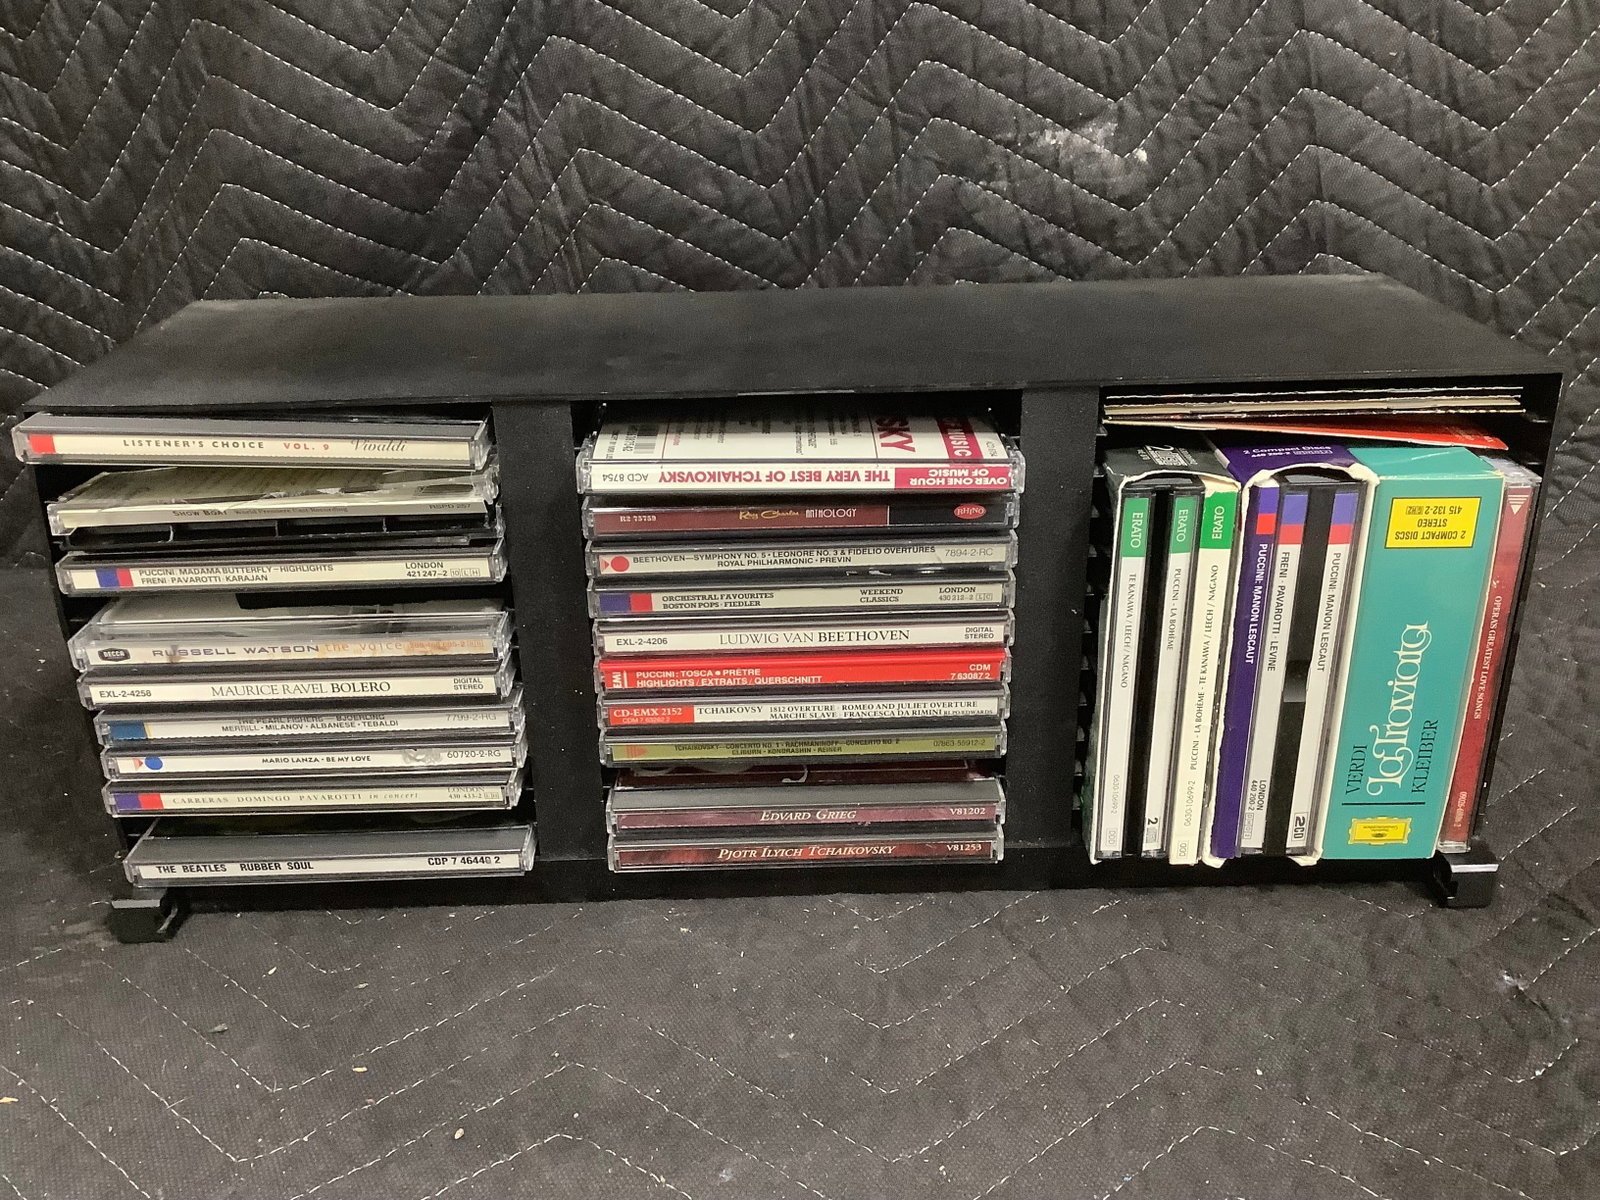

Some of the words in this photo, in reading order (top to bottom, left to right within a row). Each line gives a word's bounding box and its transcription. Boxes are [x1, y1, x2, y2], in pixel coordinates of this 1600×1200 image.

[123, 439, 204, 448] LISTENER'S
[212, 440, 264, 449] CHOICE
[283, 442, 315, 450] VOL.
[322, 443, 330, 451] 9
[350, 438, 408, 452] Vivaldi
[602, 473, 625, 482] 8754
[627, 473, 649, 482] ACD
[658, 471, 762, 483] TCHAIKOVSKY
[765, 470, 786, 483] OF
[789, 470, 822, 482] BEST
[826, 470, 862, 482] VERY
[865, 469, 890, 482] THE
[928, 468, 970, 477] MUSIC
[972, 468, 989, 477] OF
[909, 477, 947, 486] HOUR
[948, 477, 974, 486] ONE
[976, 477, 1008, 486] OVER
[956, 507, 985, 516] RHINO
[1424, 505, 1446, 515] 132-2
[1448, 505, 1463, 515] 415
[1176, 509, 1189, 542] ERATO
[1211, 505, 1225, 540] ERATO
[1417, 518, 1448, 528] STEREO
[1130, 512, 1144, 548] ERATO
[1394, 531, 1419, 540] DISCS
[1421, 530, 1458, 540] COMPACT
[1461, 530, 1467, 539] 2
[772, 550, 815, 558] LEONORE
[848, 547, 883, 555] FIDELIO
[884, 546, 936, 554] OVERTURES
[747, 557, 813, 566] PHILHARMONIC
[820, 556, 852, 564] PREVIN
[1255, 543, 1269, 585] PUCCINI:
[1279, 551, 1290, 578] FRENI
[178, 567, 222, 576] MADAMA
[222, 565, 272, 575] BUTTERFLY
[280, 564, 334, 573] HIGHLIGHTS
[405, 561, 444, 570] LONDON
[1327, 552, 1341, 592] PUCCINI:
[171, 576, 222, 584] PAVAROTTI
[225, 574, 268, 583] KARAJAN
[1129, 573, 1137, 582] TE
[1207, 564, 1219, 604] NAGANO
[1172, 568, 1182, 602] PUCCINI
[662, 594, 719, 602] ORCHESTRAL
[720, 592, 775, 600] FAVOURITES
[860, 588, 904, 596] WEEKEND
[939, 586, 976, 594] LONDON
[1125, 582, 1136, 618] KANAWA
[1249, 586, 1263, 622] MANON
[1272, 585, 1286, 634] PAVAROTTI
[1170, 607, 1178, 618] LA
[1322, 594, 1335, 632] MANON
[1205, 609, 1214, 633] LEECH
[616, 637, 668, 646] EXL-2-4206
[720, 632, 780, 645] LUDWIG
[783, 631, 814, 643] VAN
[818, 629, 910, 642] BEETHOVEN
[964, 632, 995, 640] STEREO
[1123, 623, 1133, 648] LEECH
[103, 650, 125, 658] DECCA
[151, 648, 236, 657] RUSSELL
[243, 645, 319, 654] WATSON
[325, 642, 349, 651] the
[359, 641, 402, 651] voice
[1245, 623, 1258, 665] LESCAUT
[1482, 630, 1497, 670] GREATEST
[1200, 640, 1211, 676] KANAWA
[1267, 640, 1279, 672] LEVINE
[1317, 632, 1329, 672] LESCAUT
[1120, 654, 1130, 688] NAGANO
[612, 671, 622, 688] EMI
[637, 679, 695, 688] HIGHLIGHTS
[701, 678, 747, 686] EXTRAITS
[754, 675, 822, 685] QUERSCHNITT
[1198, 676, 1207, 685] TE
[1478, 672, 1489, 693] LOVE
[98, 689, 152, 698] EXL-2-4258
[211, 684, 280, 697] MAURICE
[281, 683, 328, 695] RAVEL
[331, 681, 391, 693] BOLERO
[613, 707, 659, 718] CD-EMX
[661, 707, 683, 716] 2152
[698, 706, 762, 715] TCHAIKOVSY
[841, 703, 874, 711] ROMEO
[896, 702, 928, 711] JULIET
[843, 710, 895, 718] FRANCESCA
[1473, 694, 1484, 720] SONGS
[265, 723, 304, 731] MILANOV
[310, 721, 356, 729] ALBANESE
[1194, 723, 1201, 734] LA
[446, 750, 502, 759] 60720-2-RG
[1189, 740, 1200, 771] PUCCINI
[1411, 719, 1439, 793] KLEIBER
[1345, 744, 1368, 795] VERDI
[172, 796, 229, 804] CARRERAS
[237, 795, 291, 803] DOMINGO
[299, 793, 362, 801] PAVAROTTI
[1256, 779, 1267, 811] LONDON
[760, 810, 812, 821] EDVARD
[815, 809, 857, 820] GRIEG
[950, 807, 986, 815] V81202
[1147, 817, 1159, 826] 2
[1293, 816, 1306, 839] 2CD
[807, 845, 897, 856] TCHAIKOVSKY
[155, 865, 177, 874] THE
[182, 864, 227, 873] BEATLES
[240, 862, 282, 872] RUBBER
[287, 861, 314, 871] SOUL
[427, 857, 448, 866] CDP
[451, 857, 457, 865] 7
[494, 856, 500, 864] 2
